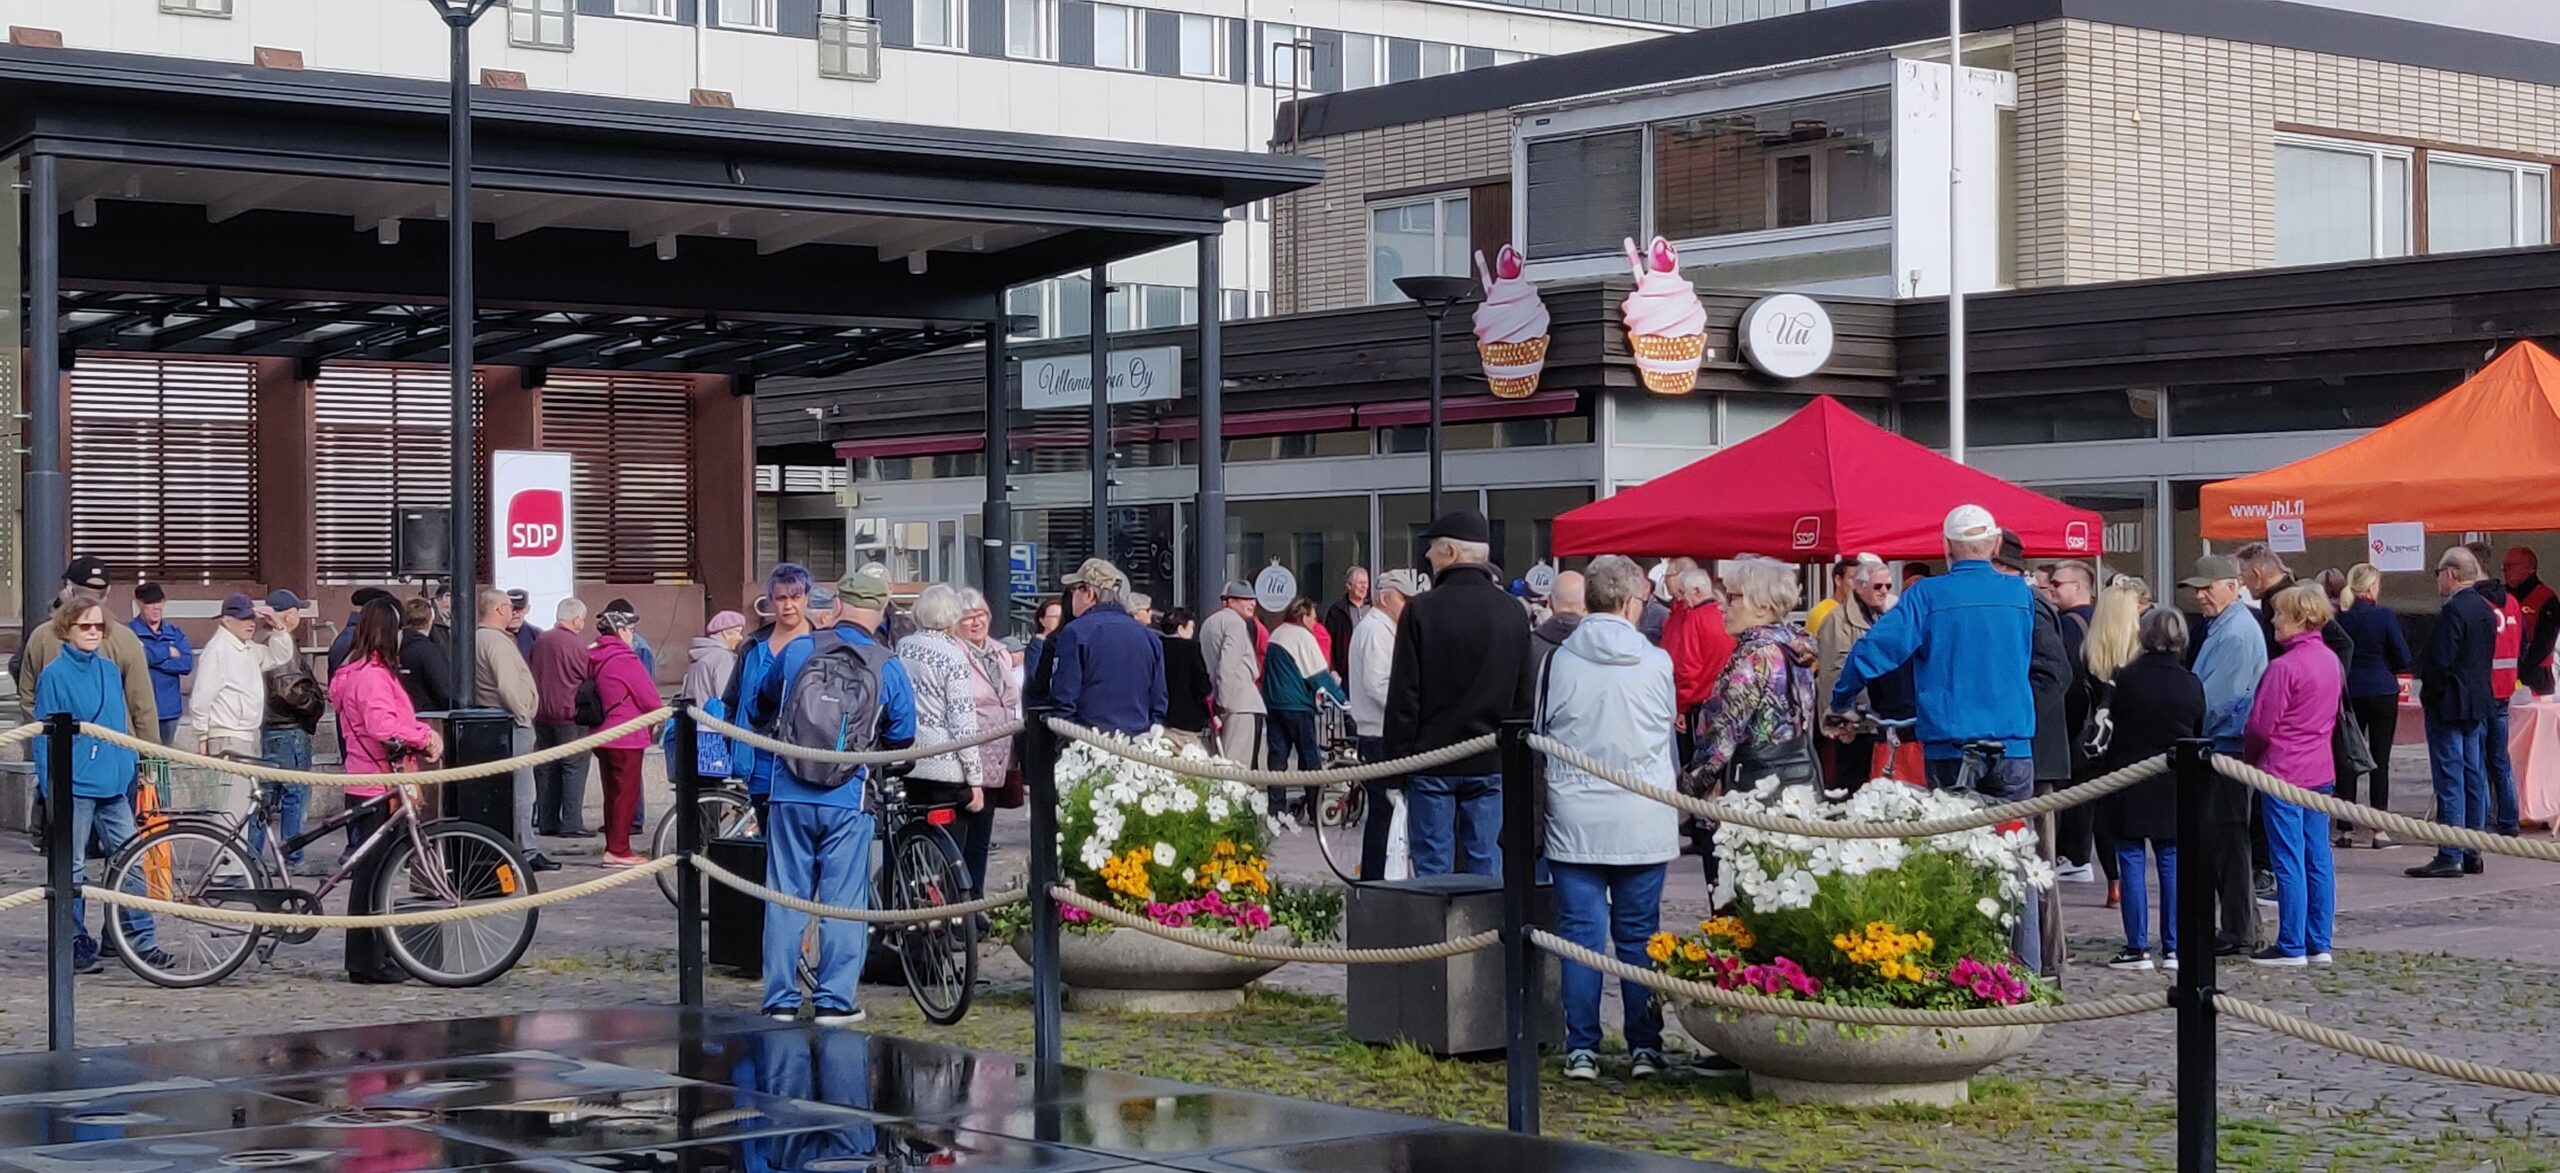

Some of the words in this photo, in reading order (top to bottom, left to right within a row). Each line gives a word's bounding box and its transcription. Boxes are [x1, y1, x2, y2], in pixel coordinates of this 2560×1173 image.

[1129, 356, 1155, 397] Oy
[2229, 499, 2305, 519] www.jhl.fi
[512, 522, 558, 549] SDP
[1796, 531, 1816, 545] SDP
[2068, 536, 2085, 548] SDP
